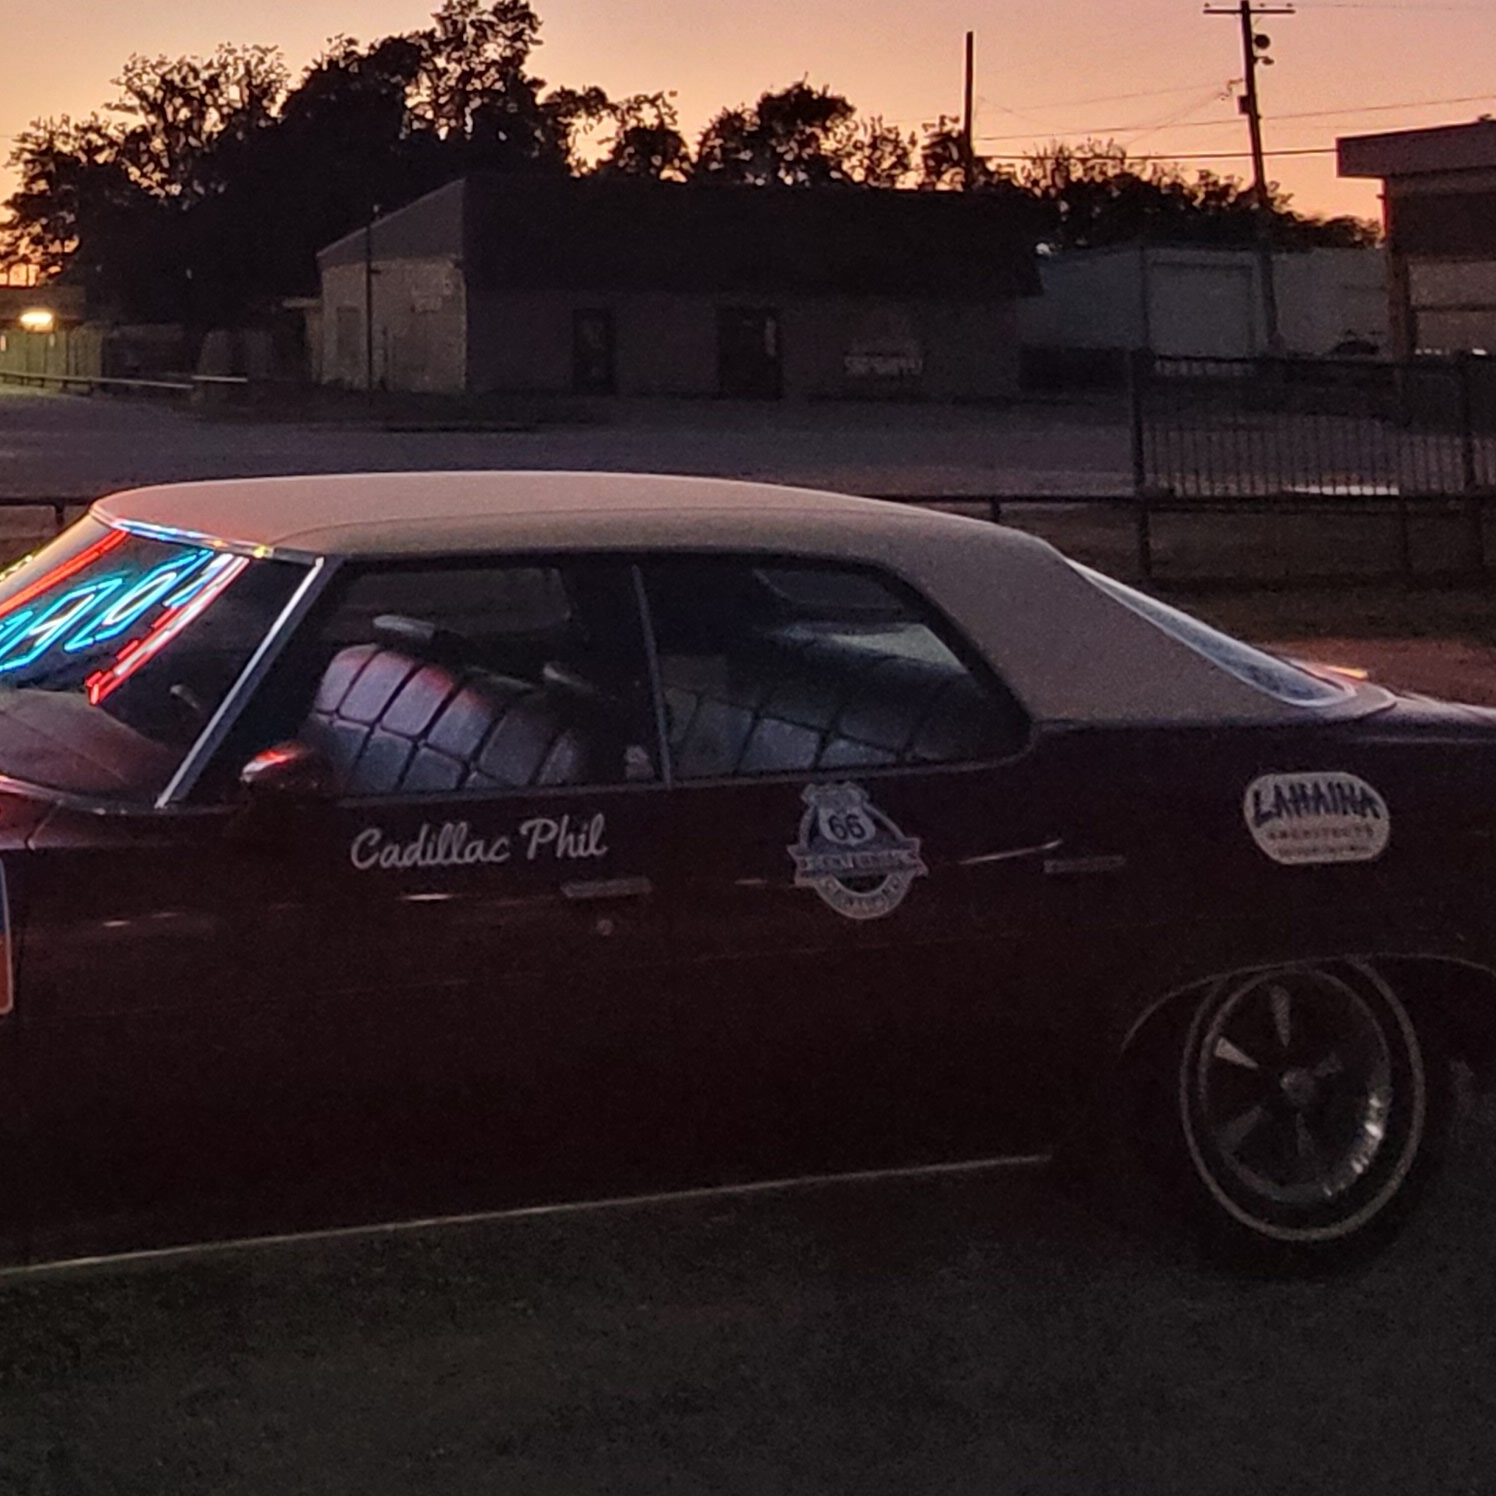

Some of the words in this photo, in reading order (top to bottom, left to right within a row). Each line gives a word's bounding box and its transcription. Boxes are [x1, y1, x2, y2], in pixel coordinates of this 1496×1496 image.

[350, 821, 510, 870] Cadillac
[520, 812, 608, 860] Phil
[827, 814, 866, 841] 66
